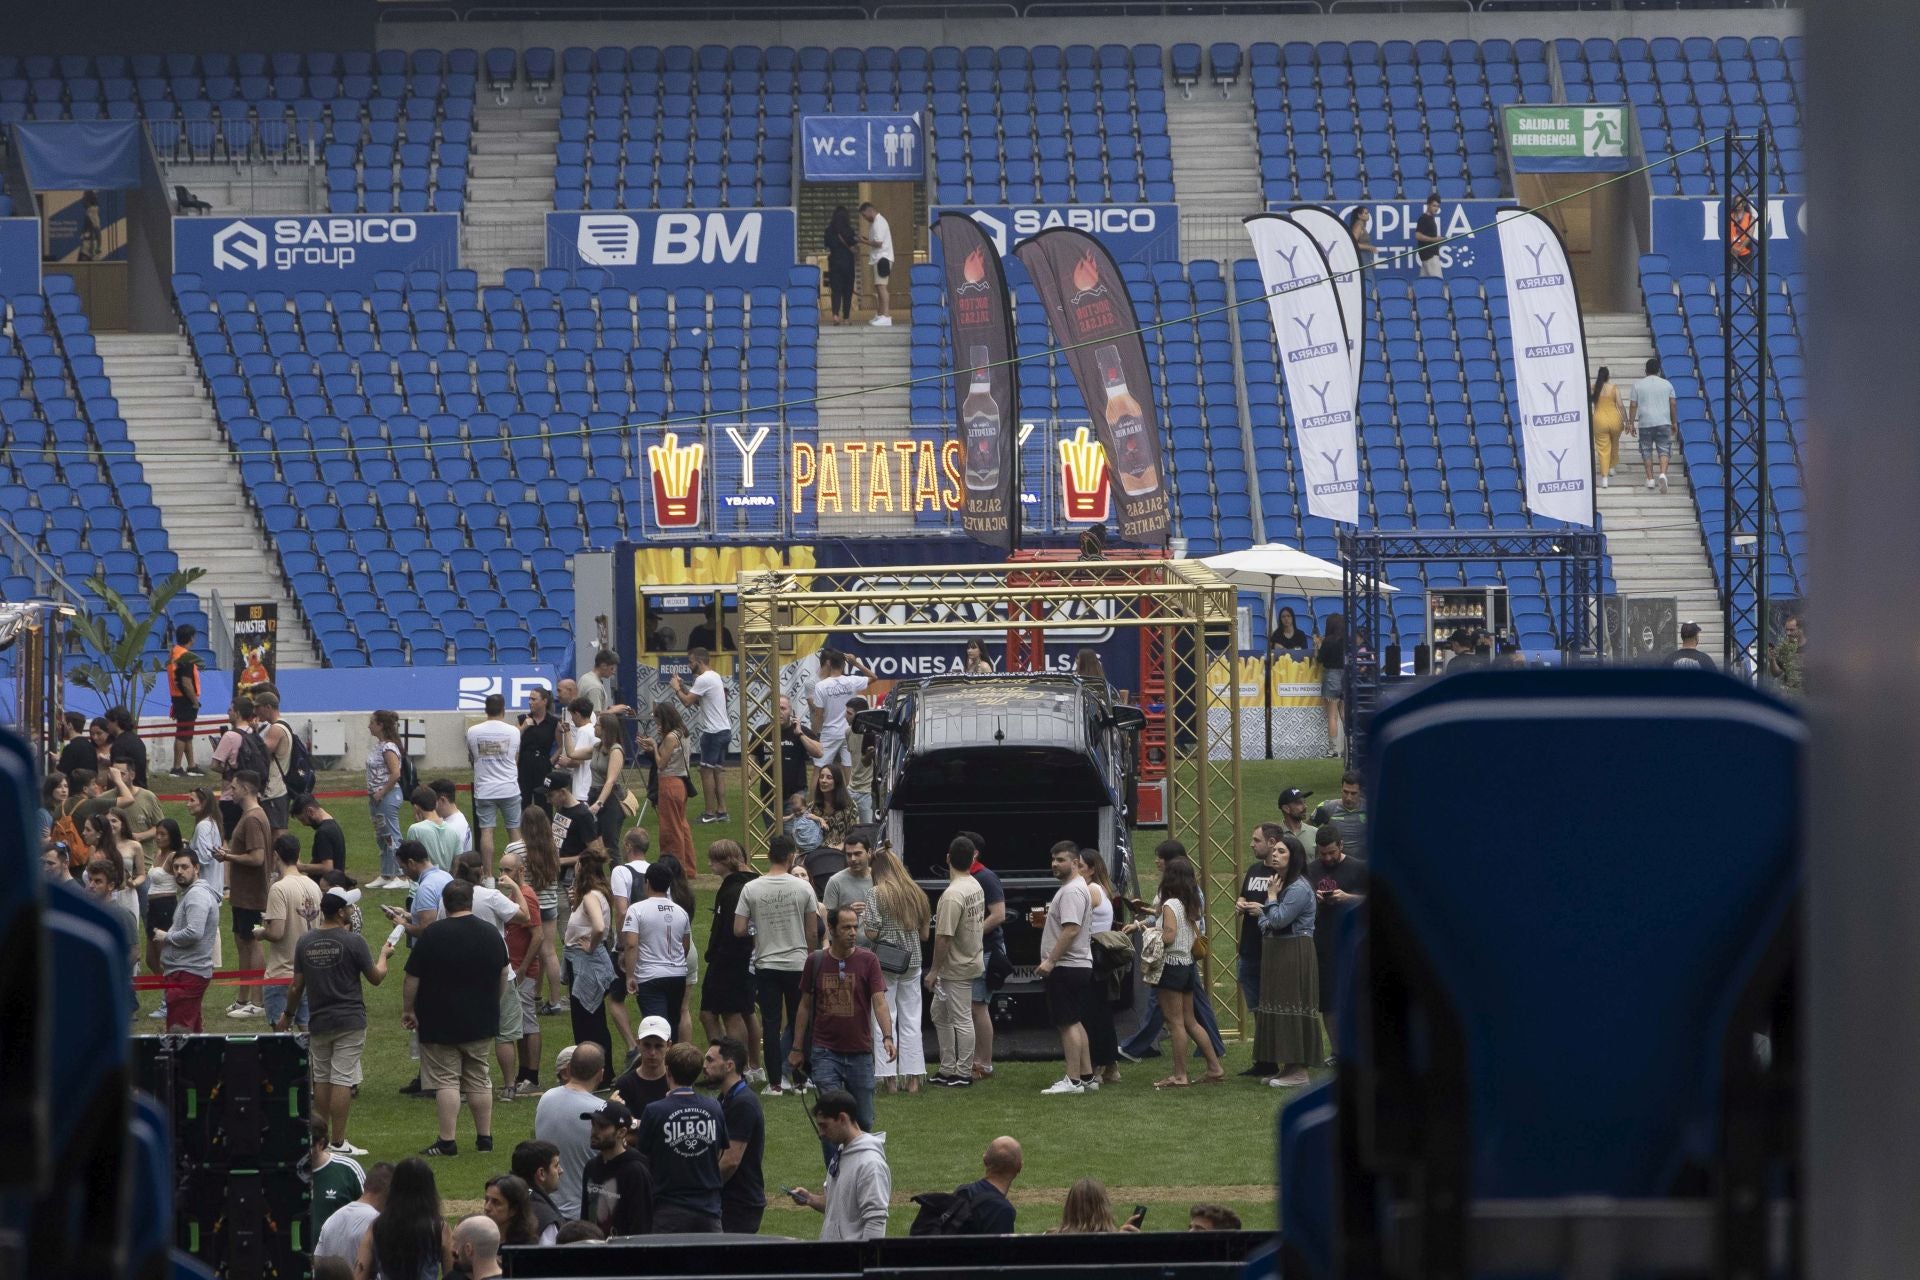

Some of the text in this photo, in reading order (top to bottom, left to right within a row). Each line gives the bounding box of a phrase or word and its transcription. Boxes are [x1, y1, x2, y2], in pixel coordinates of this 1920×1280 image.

[1519, 118, 1570, 131] SALIDA DE
[1512, 134, 1577, 146] EMERGENCIA
[274, 219, 417, 244] SABICO
[1013, 208, 1156, 233] SABICO
[652, 212, 762, 264] BM
[275, 248, 355, 269] group
[726, 427, 770, 487] Y
[791, 440, 961, 514] PATATAS
[725, 496, 775, 506] YBARRA
[234, 620, 266, 633] MONSTER
[663, 1119, 717, 1144] SILBON
